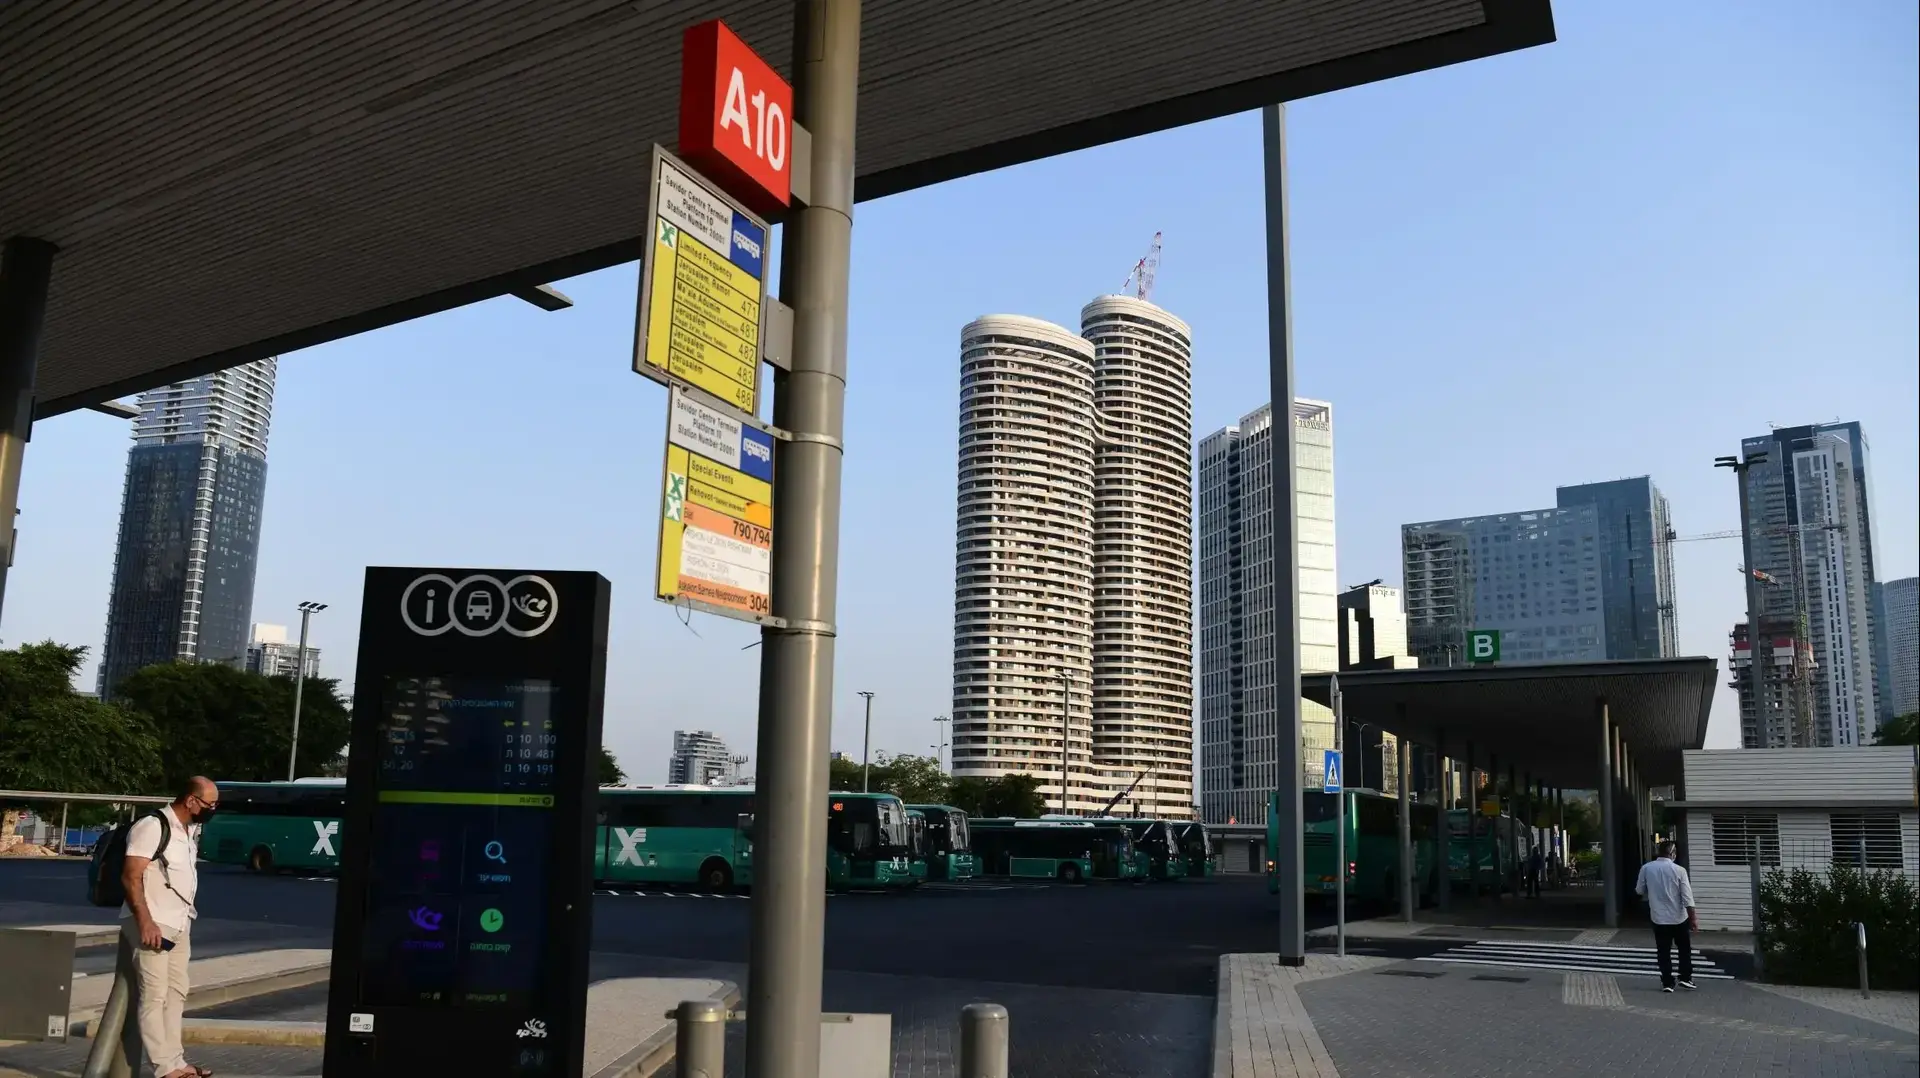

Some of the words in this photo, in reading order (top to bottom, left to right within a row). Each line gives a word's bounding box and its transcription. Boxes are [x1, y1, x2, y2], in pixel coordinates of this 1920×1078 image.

[719, 66, 786, 172] A10
[667, 199, 687, 218] Station
[688, 214, 708, 232] Number
[683, 198, 705, 219] Platform
[706, 214, 713, 226] 10
[688, 191, 706, 208] Centre
[707, 204, 729, 224] Terminal
[680, 240, 702, 259] Limited
[702, 254, 732, 280] Frequency
[675, 305, 706, 327] Jerusalem
[741, 300, 756, 318] 471
[674, 329, 705, 350] Jerusalem
[740, 321, 755, 339] 481
[738, 343, 754, 361] 482
[672, 353, 703, 373] Jerusalem
[737, 365, 753, 383] 483
[692, 419, 715, 435] Platform
[716, 418, 739, 434] Terminal
[677, 424, 697, 438] Station
[698, 433, 718, 448] Number
[691, 460, 713, 476] Special
[713, 469, 733, 484] Events
[733, 520, 770, 546] 790,794
[749, 594, 768, 612] 304
[1474, 634, 1494, 658] B
[520, 734, 532, 744] 10
[519, 748, 531, 759] 10
[536, 749, 554, 759] 481
[518, 763, 530, 774] 10
[537, 764, 553, 773] 191
